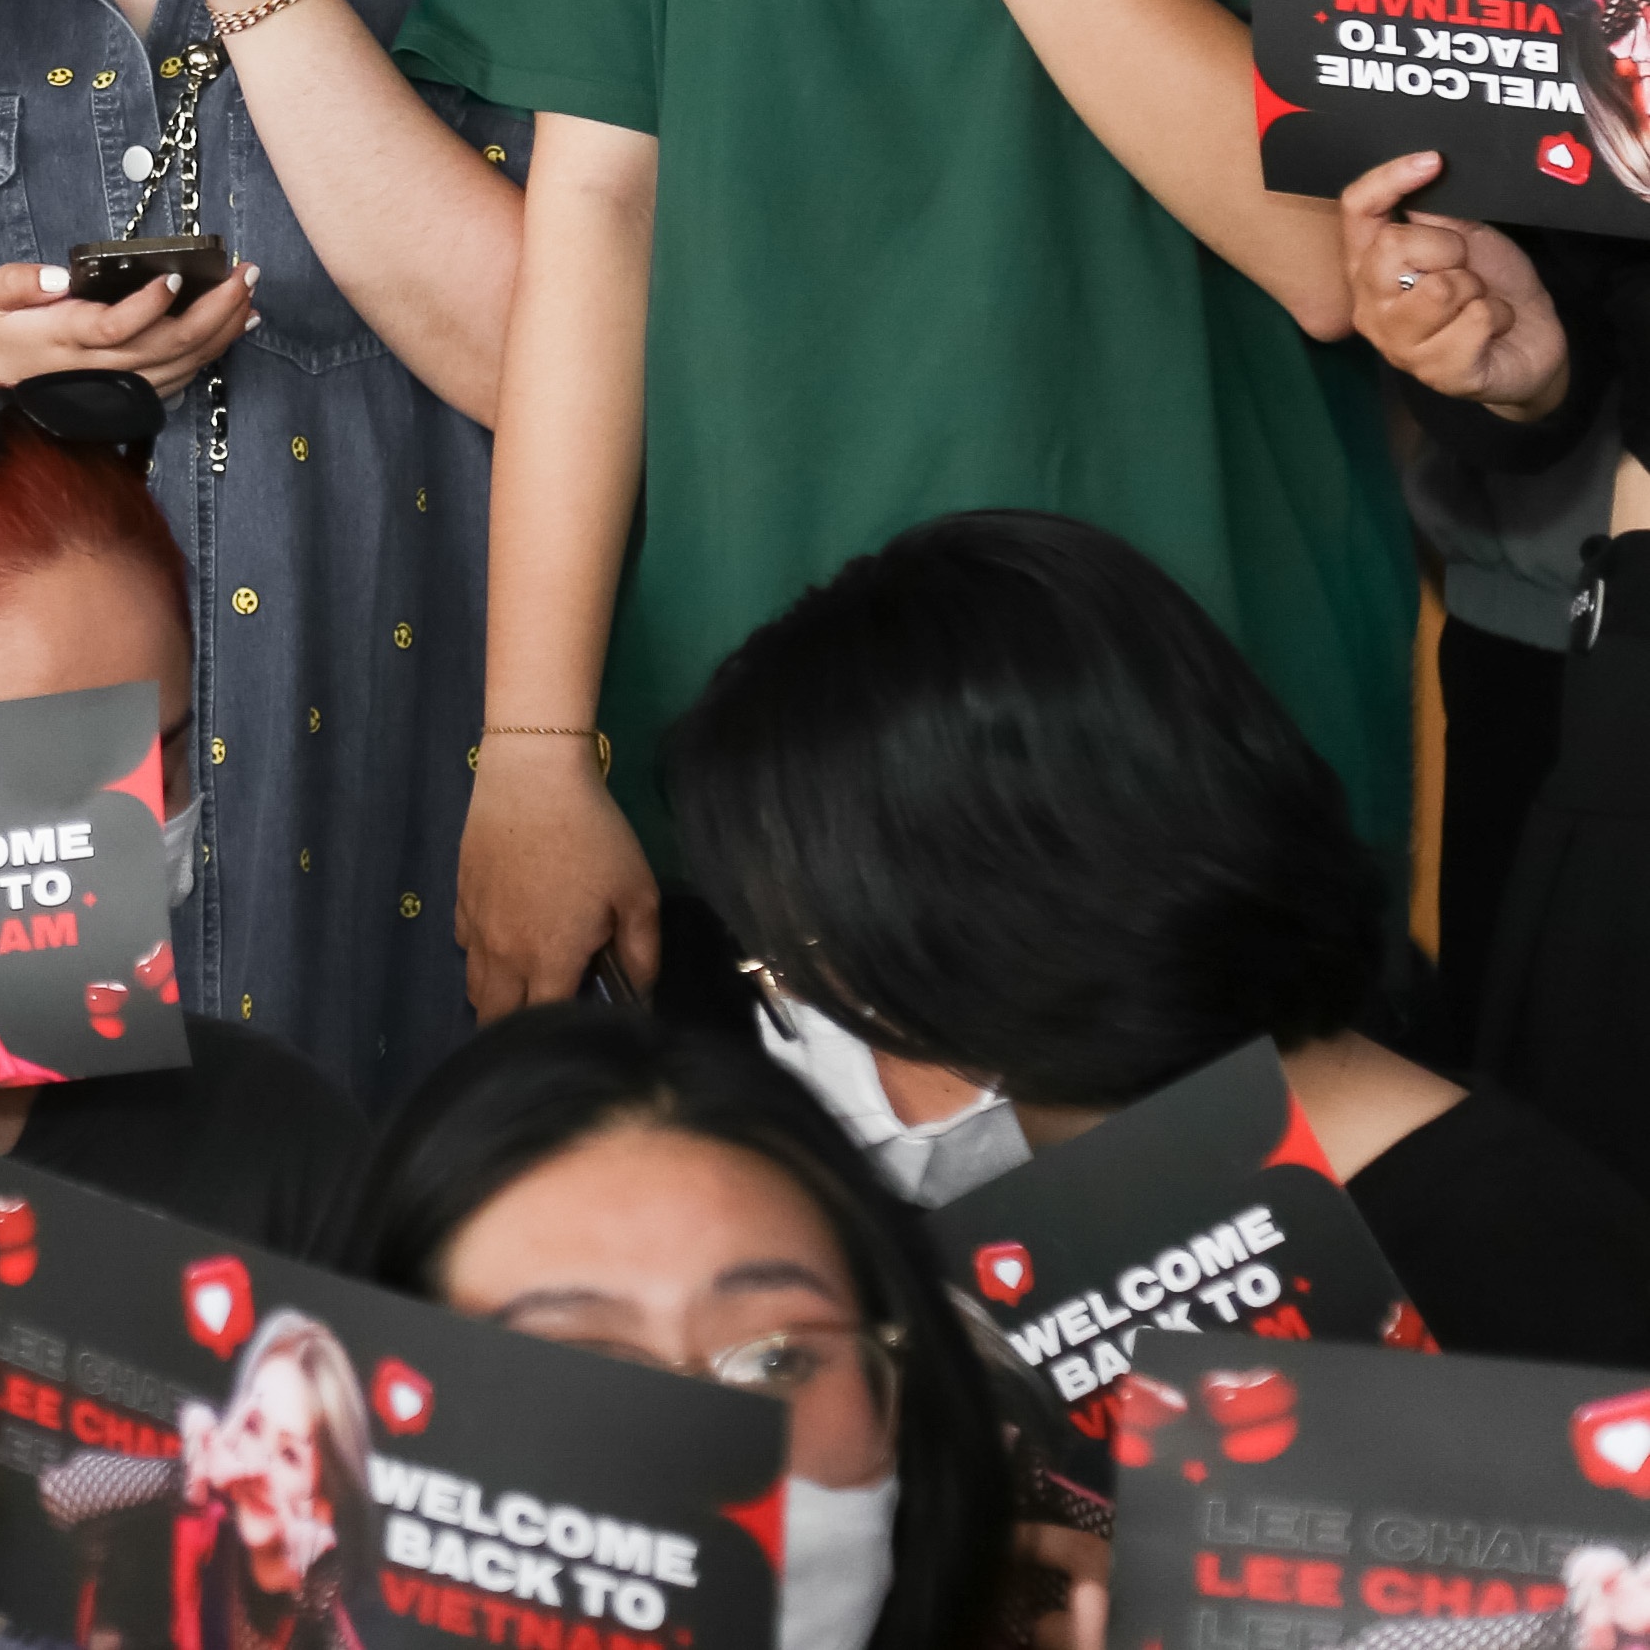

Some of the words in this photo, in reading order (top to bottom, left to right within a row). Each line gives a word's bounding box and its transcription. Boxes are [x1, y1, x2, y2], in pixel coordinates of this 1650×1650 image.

[1338, 19, 1406, 56] TO
[1416, 28, 1559, 73] BACK
[1316, 54, 1585, 115] WELCOME
[1007, 1205, 1287, 1366] WELCOME
[1198, 1262, 1282, 1323] TO
[367, 1453, 698, 1589] WELCOME
[384, 1513, 562, 1607] BACK
[573, 1563, 666, 1631] TO
[1195, 1552, 1345, 1609] LEE
